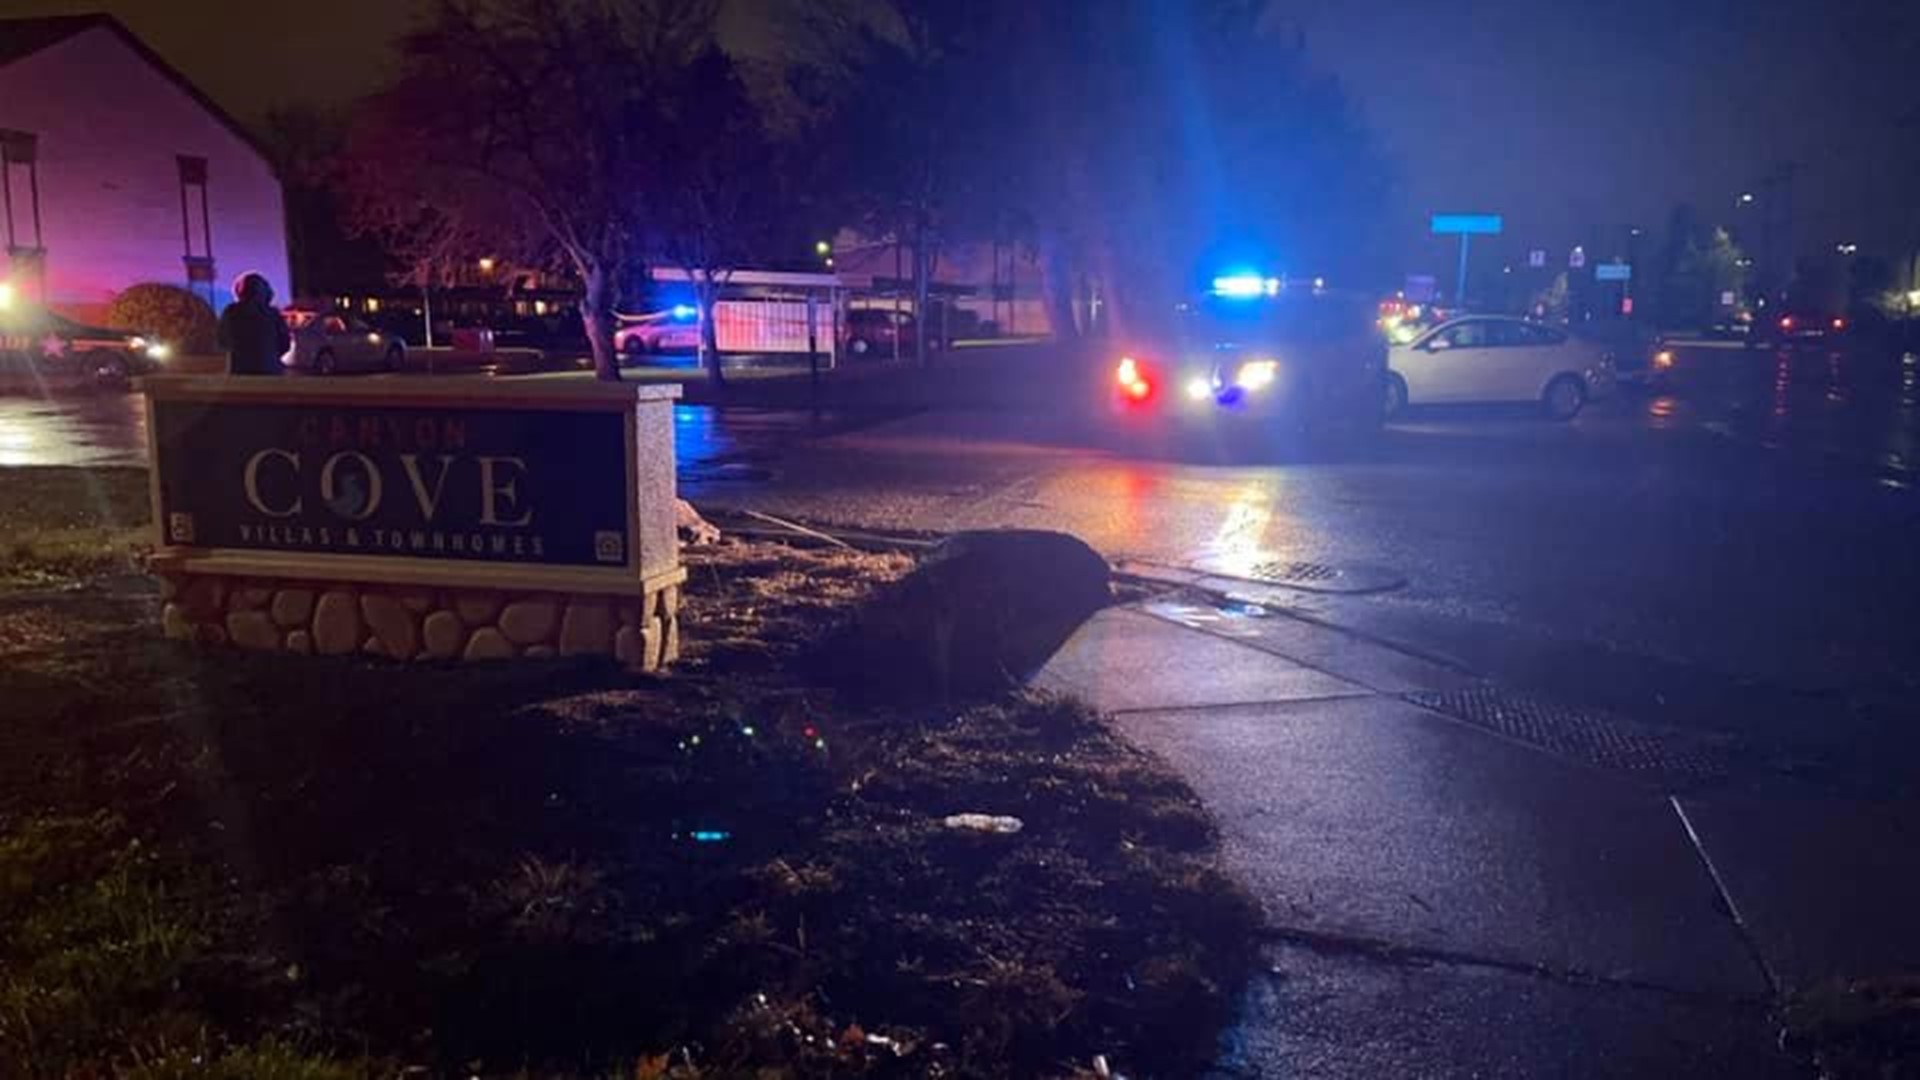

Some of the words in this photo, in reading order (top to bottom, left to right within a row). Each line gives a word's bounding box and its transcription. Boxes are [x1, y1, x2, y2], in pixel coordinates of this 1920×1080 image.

[300, 416, 467, 449] CANYON
[243, 448, 534, 527] COVE
[240, 525, 331, 546] VILLAS
[347, 528, 360, 547] &
[373, 529, 546, 556] TOWNHOMES
